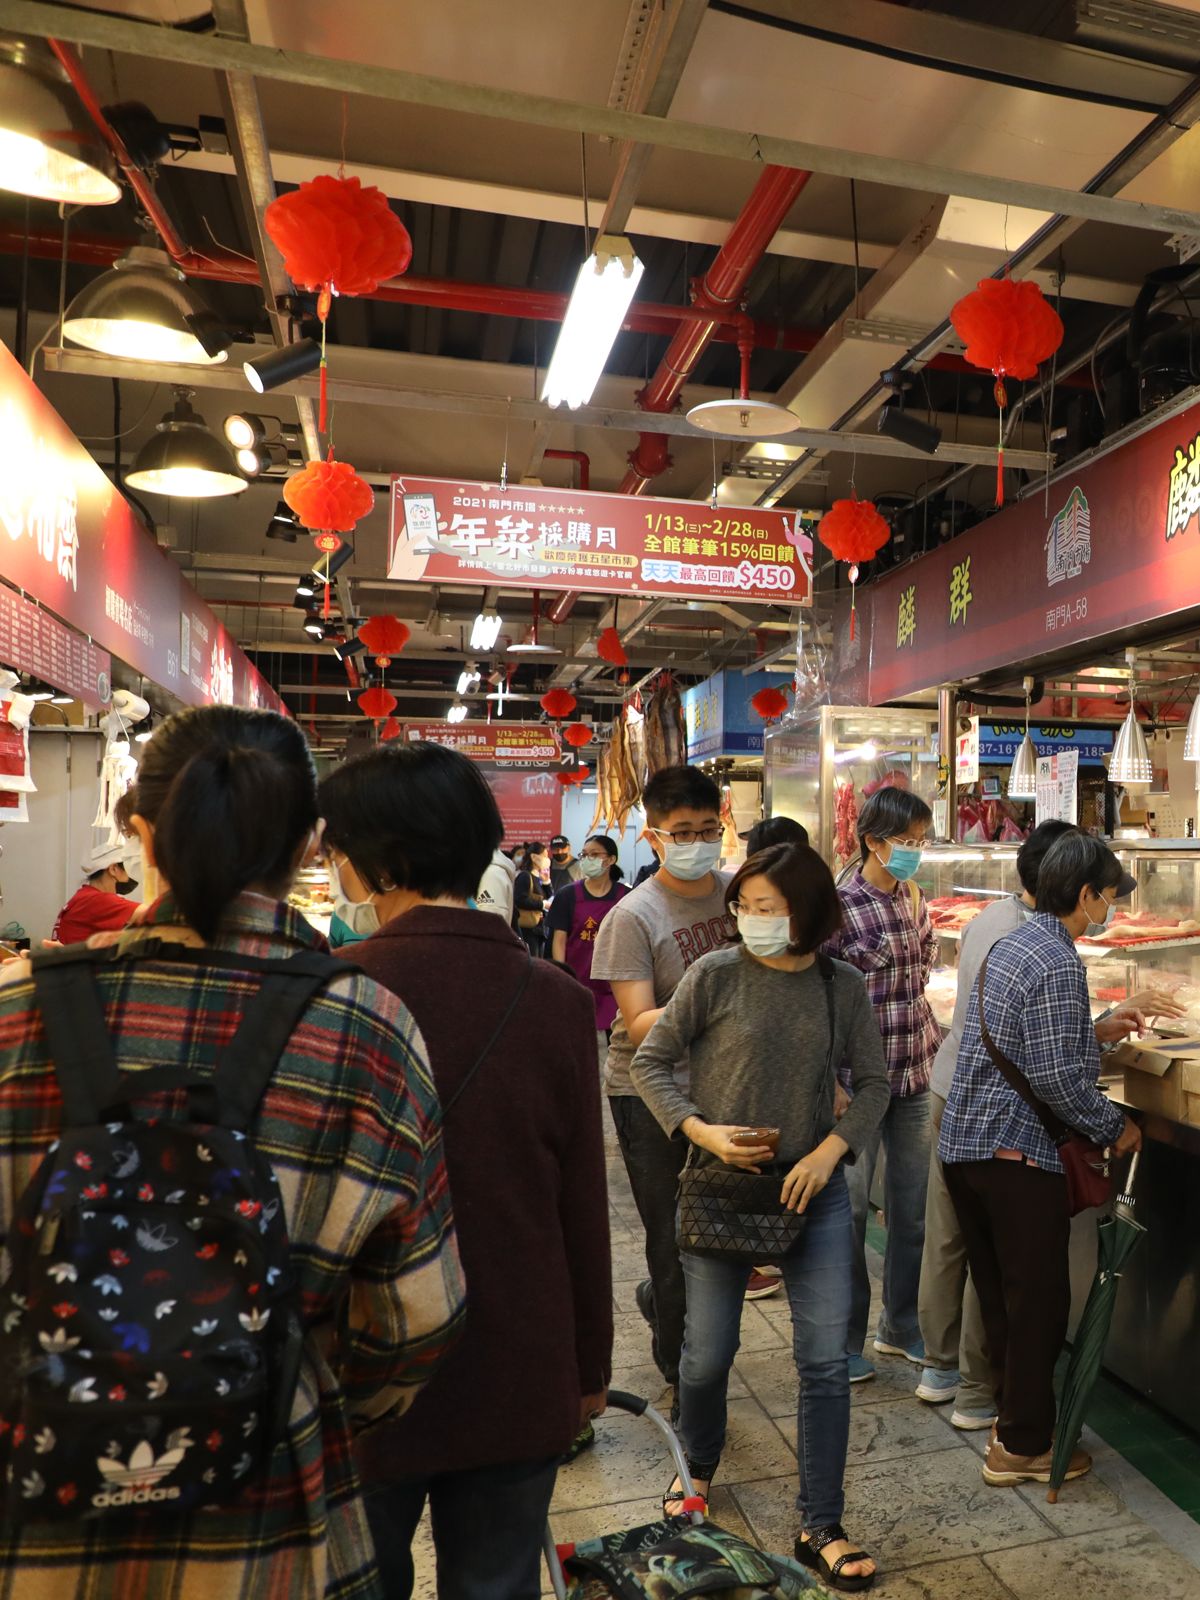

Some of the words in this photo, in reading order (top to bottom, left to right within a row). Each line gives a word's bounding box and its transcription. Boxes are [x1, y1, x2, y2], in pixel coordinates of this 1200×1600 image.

[453, 496, 536, 513] 2021南門市場
[449, 513, 616, 560] 年菜採購月
[643, 534, 795, 564] 全館筆筆15%回饋
[643, 560, 735, 585] 天天最高回饋
[739, 563, 792, 587] $450
[1045, 597, 1088, 633] 南門A-58
[91, 1484, 180, 1508] adidas
